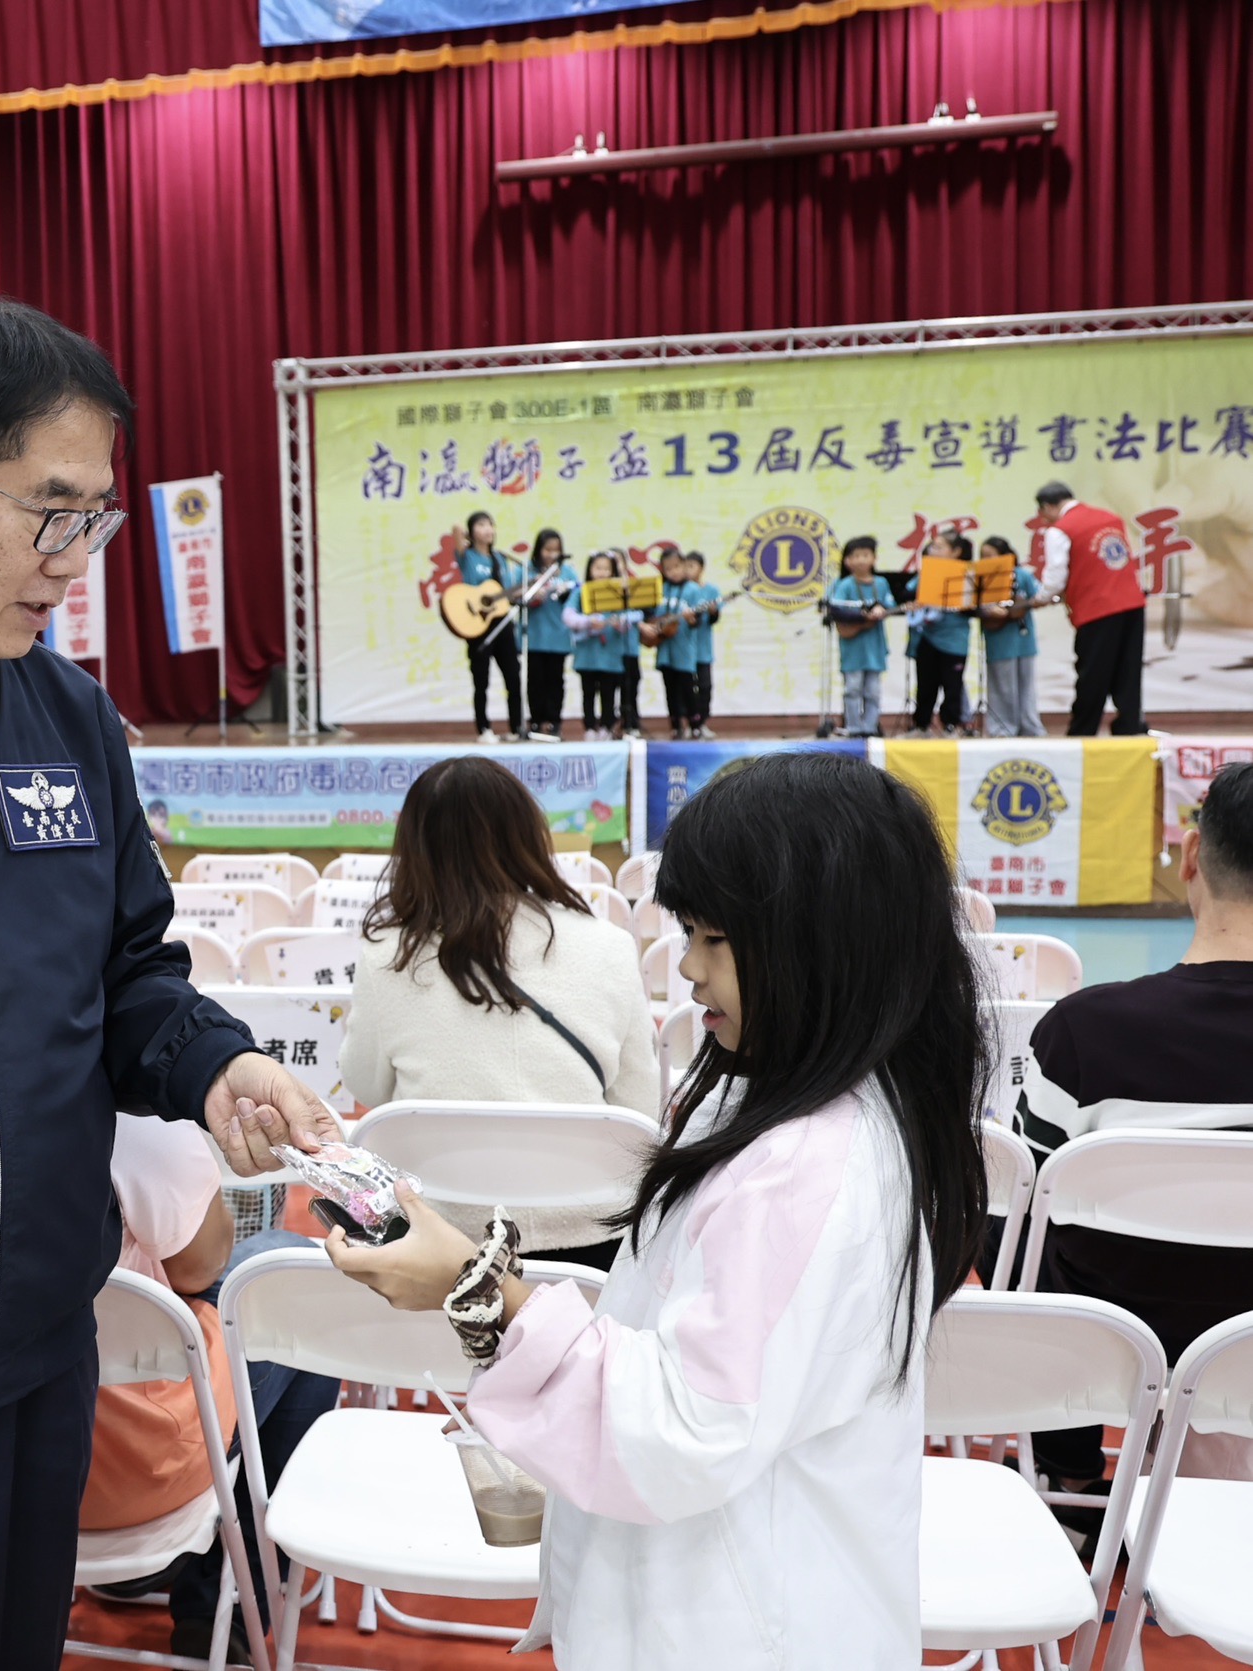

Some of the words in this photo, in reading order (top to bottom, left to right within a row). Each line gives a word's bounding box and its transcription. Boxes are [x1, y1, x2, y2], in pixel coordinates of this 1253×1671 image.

[755, 511, 819, 533] LIONS
[774, 540, 807, 579] L
[1009, 785, 1034, 817] L
[22, 809, 82, 828] 臺南市長
[36, 823, 76, 841] 黃偉哲
